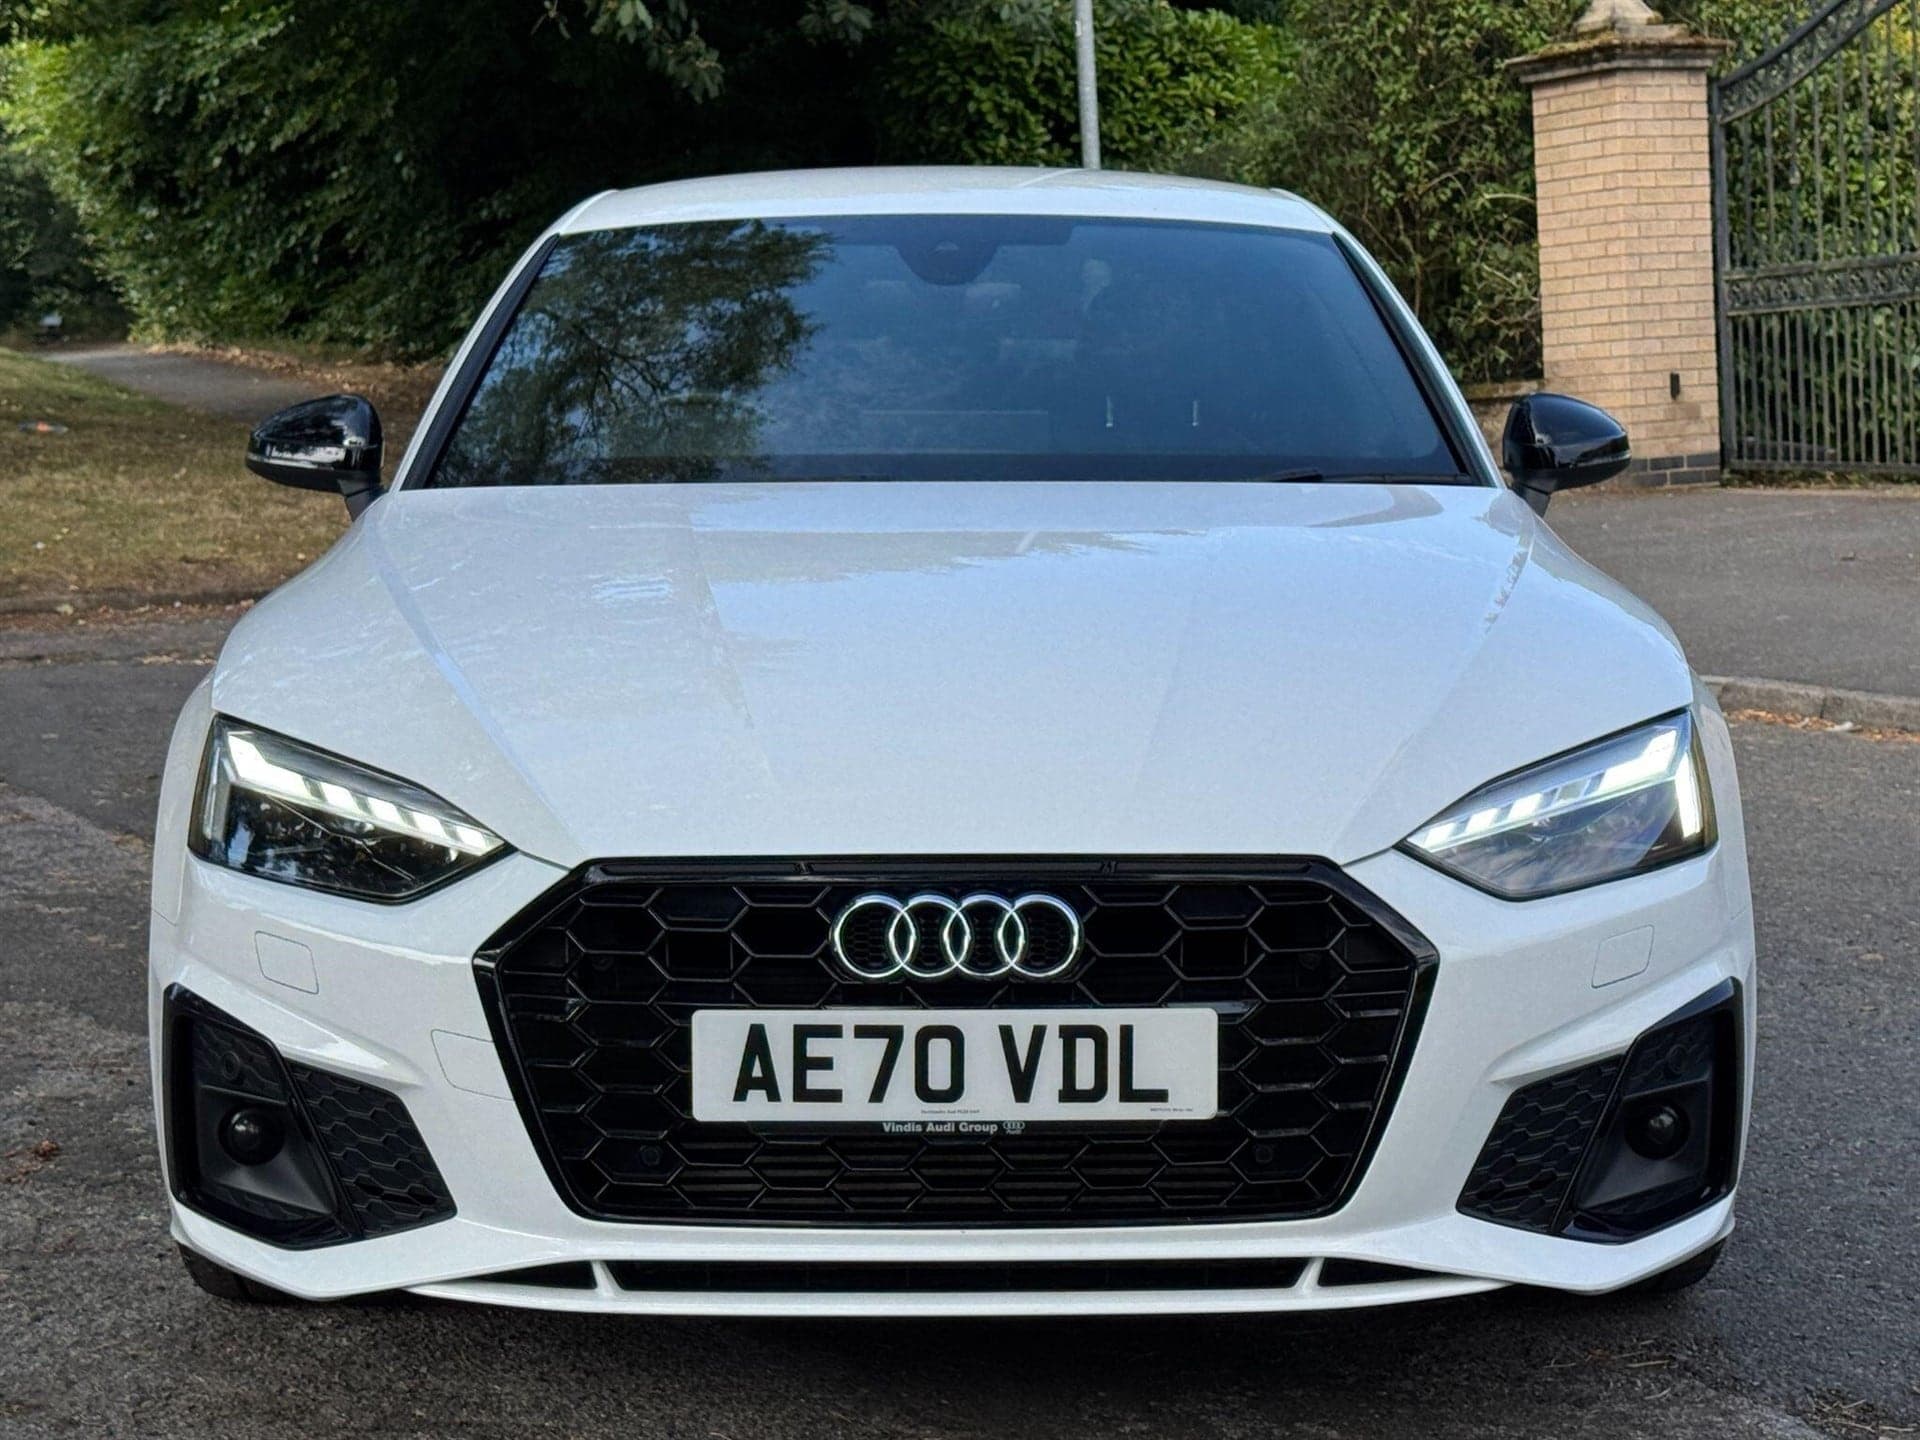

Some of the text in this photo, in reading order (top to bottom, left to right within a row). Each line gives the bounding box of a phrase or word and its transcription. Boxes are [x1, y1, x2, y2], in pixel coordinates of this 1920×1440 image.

[732, 1023, 1169, 1104] AE70 VDL
[882, 1122, 998, 1134] Vindis Audi Group
